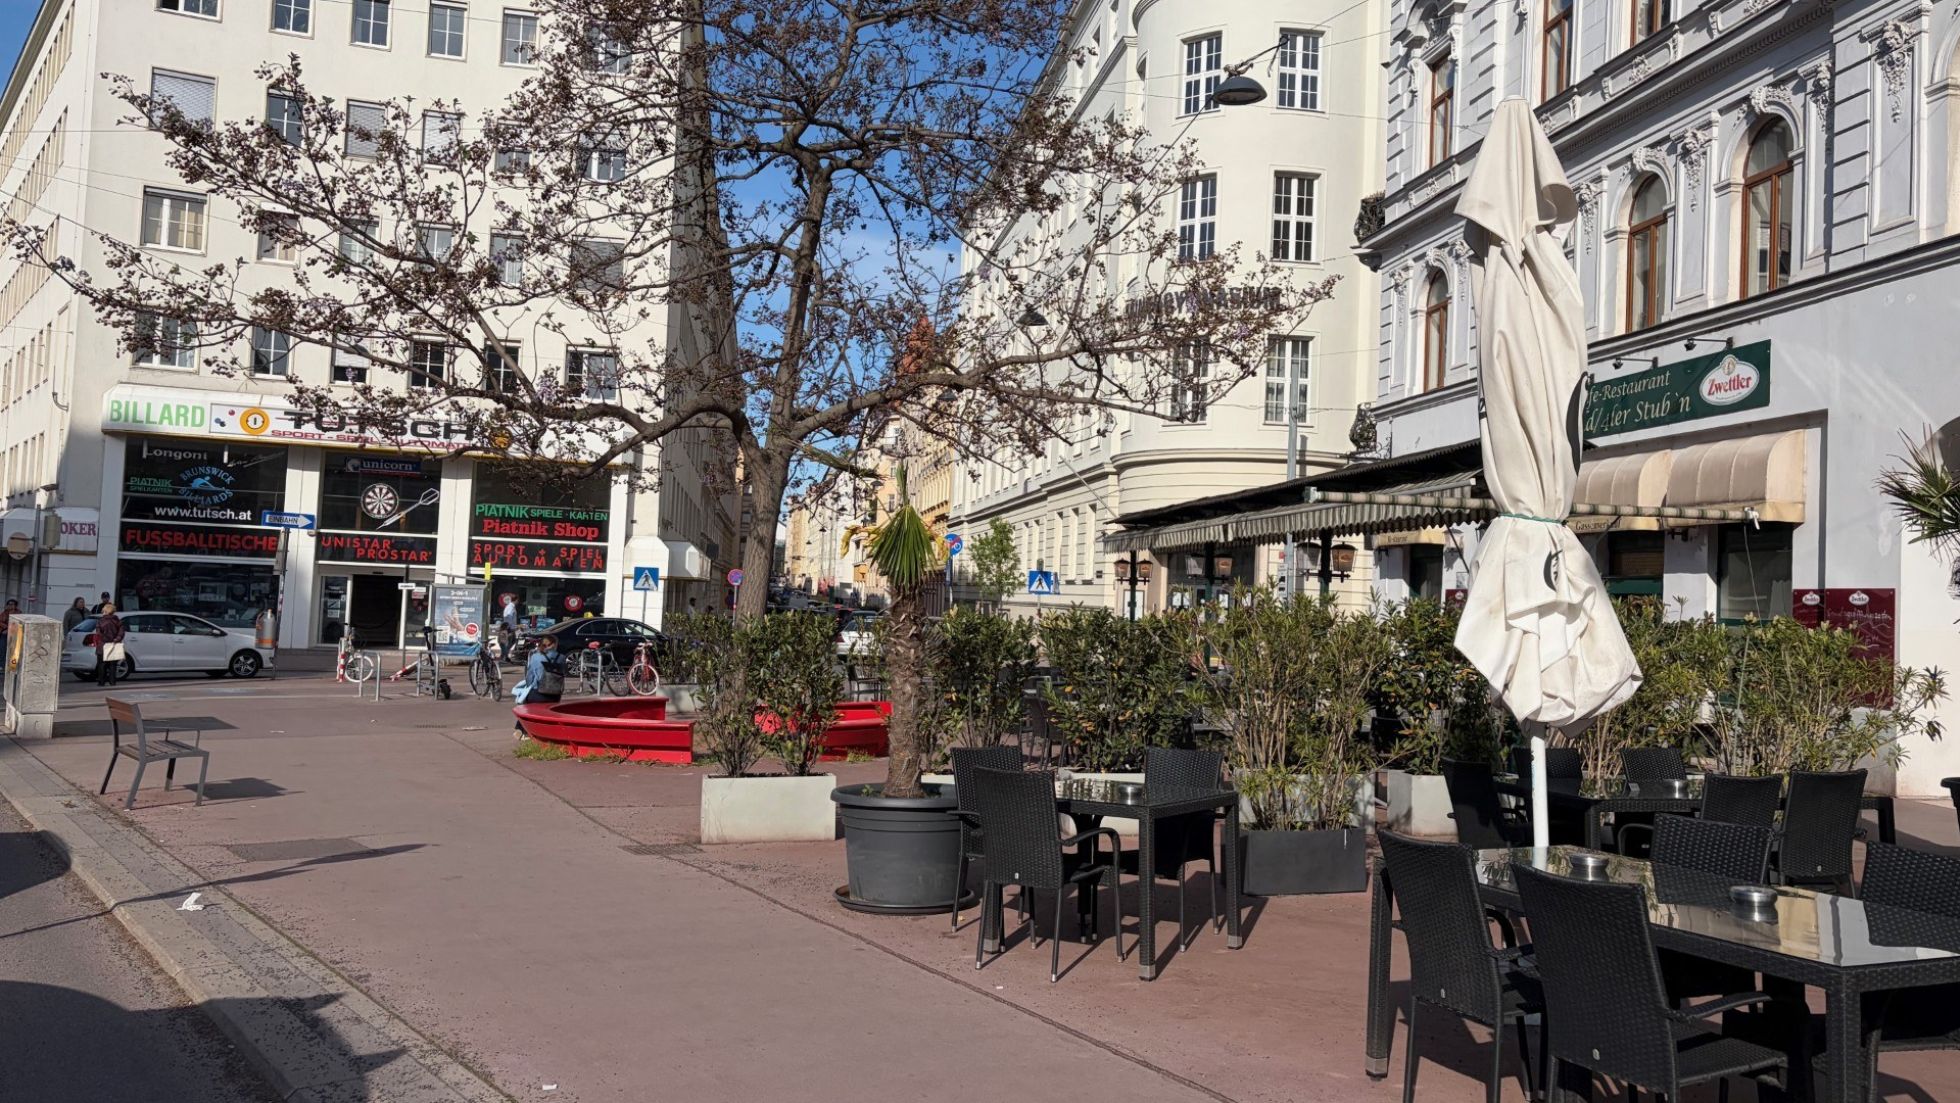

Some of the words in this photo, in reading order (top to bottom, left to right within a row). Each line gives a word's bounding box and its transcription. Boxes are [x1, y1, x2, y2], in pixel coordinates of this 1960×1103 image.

[1586, 370, 1671, 409] fe-Restaurant
[1707, 374, 1752, 396] Zwettler
[109, 399, 205, 428] BILLARD
[271, 429, 325, 440] SPORT
[362, 459, 413, 471] unicorn
[129, 477, 173, 487] PIATNIK
[179, 466, 236, 485] BRUNSWICK
[154, 506, 252, 521] www.tutsch.at
[268, 515, 298, 524] EINBAHN
[475, 504, 529, 518] PIATNIK
[530, 509, 563, 518] SPIELE
[569, 511, 608, 521] KARTEN
[60, 521, 97, 536] OKER
[482, 519, 548, 535] Piatnik
[554, 523, 599, 540] Shop
[125, 529, 278, 551] FUSSBALLTISCHE
[321, 535, 391, 550] UNISTAR
[356, 548, 429, 562] PROSTAR
[474, 543, 525, 556] SPORT
[560, 547, 602, 560] SPIEL
[473, 553, 604, 569] AUTOMATEN
